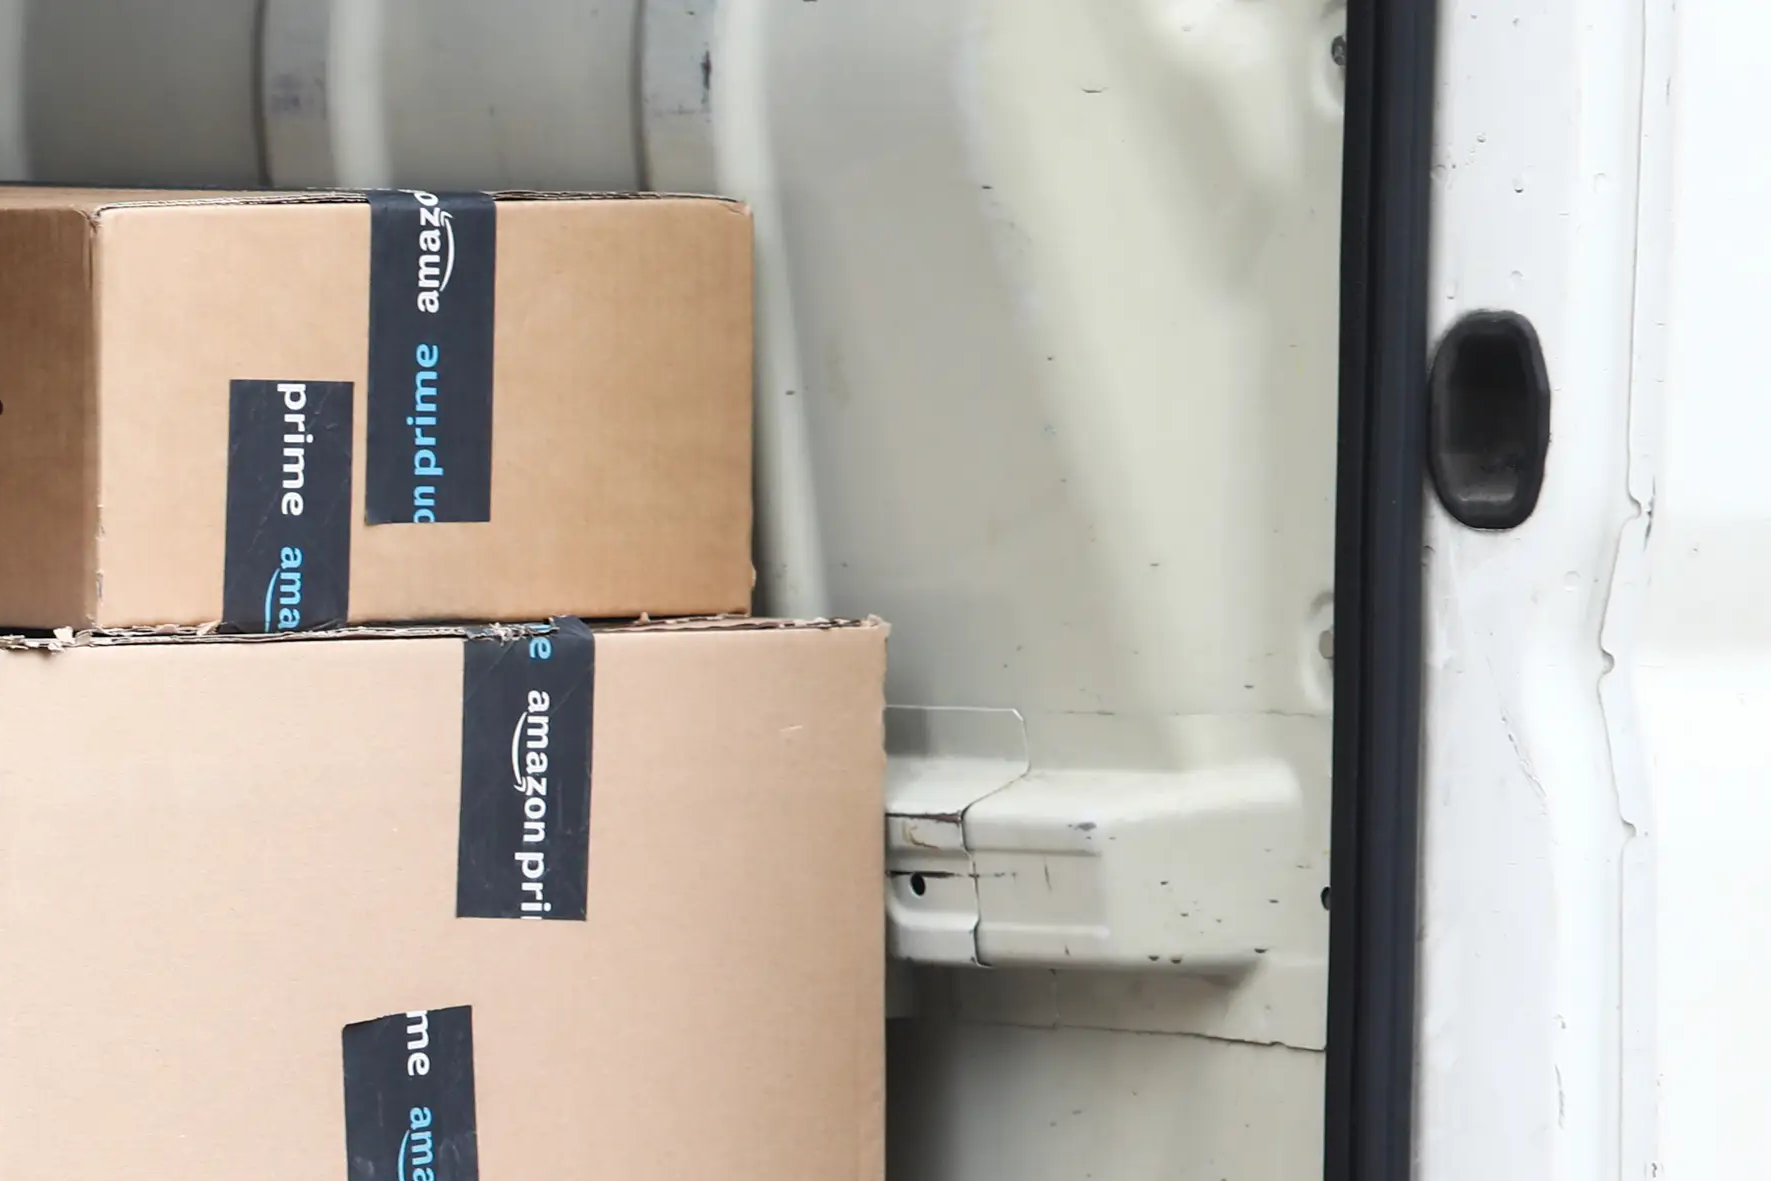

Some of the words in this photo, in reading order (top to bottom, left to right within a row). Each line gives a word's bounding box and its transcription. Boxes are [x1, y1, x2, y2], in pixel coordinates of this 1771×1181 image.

[276, 383, 314, 517] prime
[406, 343, 444, 476] prime
[524, 689, 550, 843] amazon
[514, 852, 551, 920] pri
